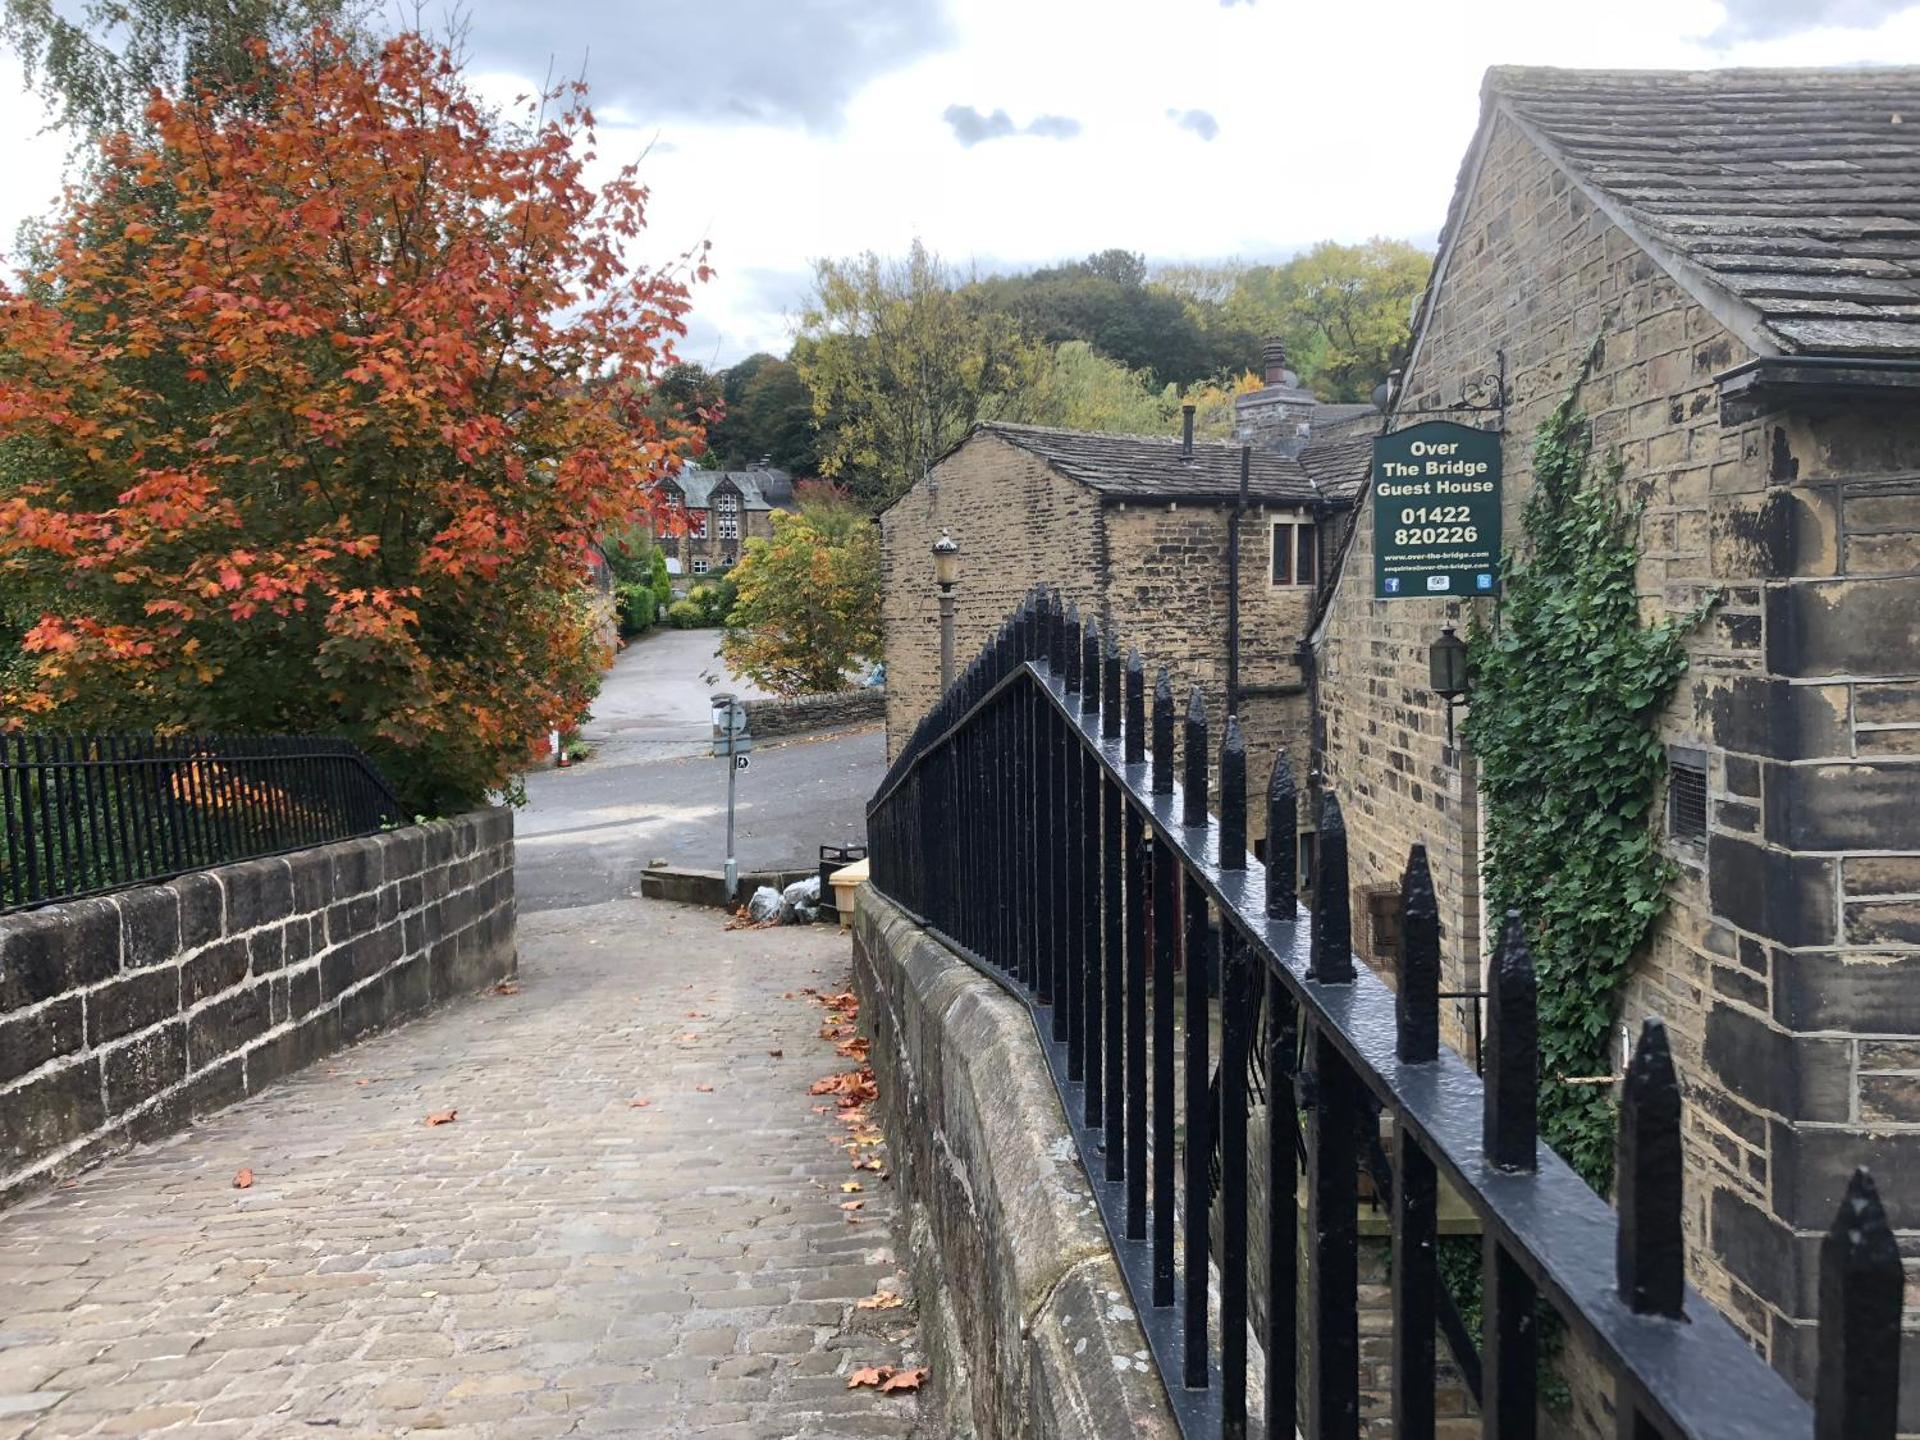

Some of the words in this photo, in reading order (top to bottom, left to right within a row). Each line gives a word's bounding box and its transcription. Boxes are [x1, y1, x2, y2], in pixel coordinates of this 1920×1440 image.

[1410, 440, 1459, 456] Over
[1382, 462, 1420, 477] The
[1425, 460, 1488, 477] Bridge
[1376, 482, 1431, 496] Guest
[1436, 480, 1494, 494] House
[1401, 506, 1471, 524] 01422
[1394, 526, 1478, 545] 820226
[1384, 551, 1489, 562] www.over-the-bridge.com
